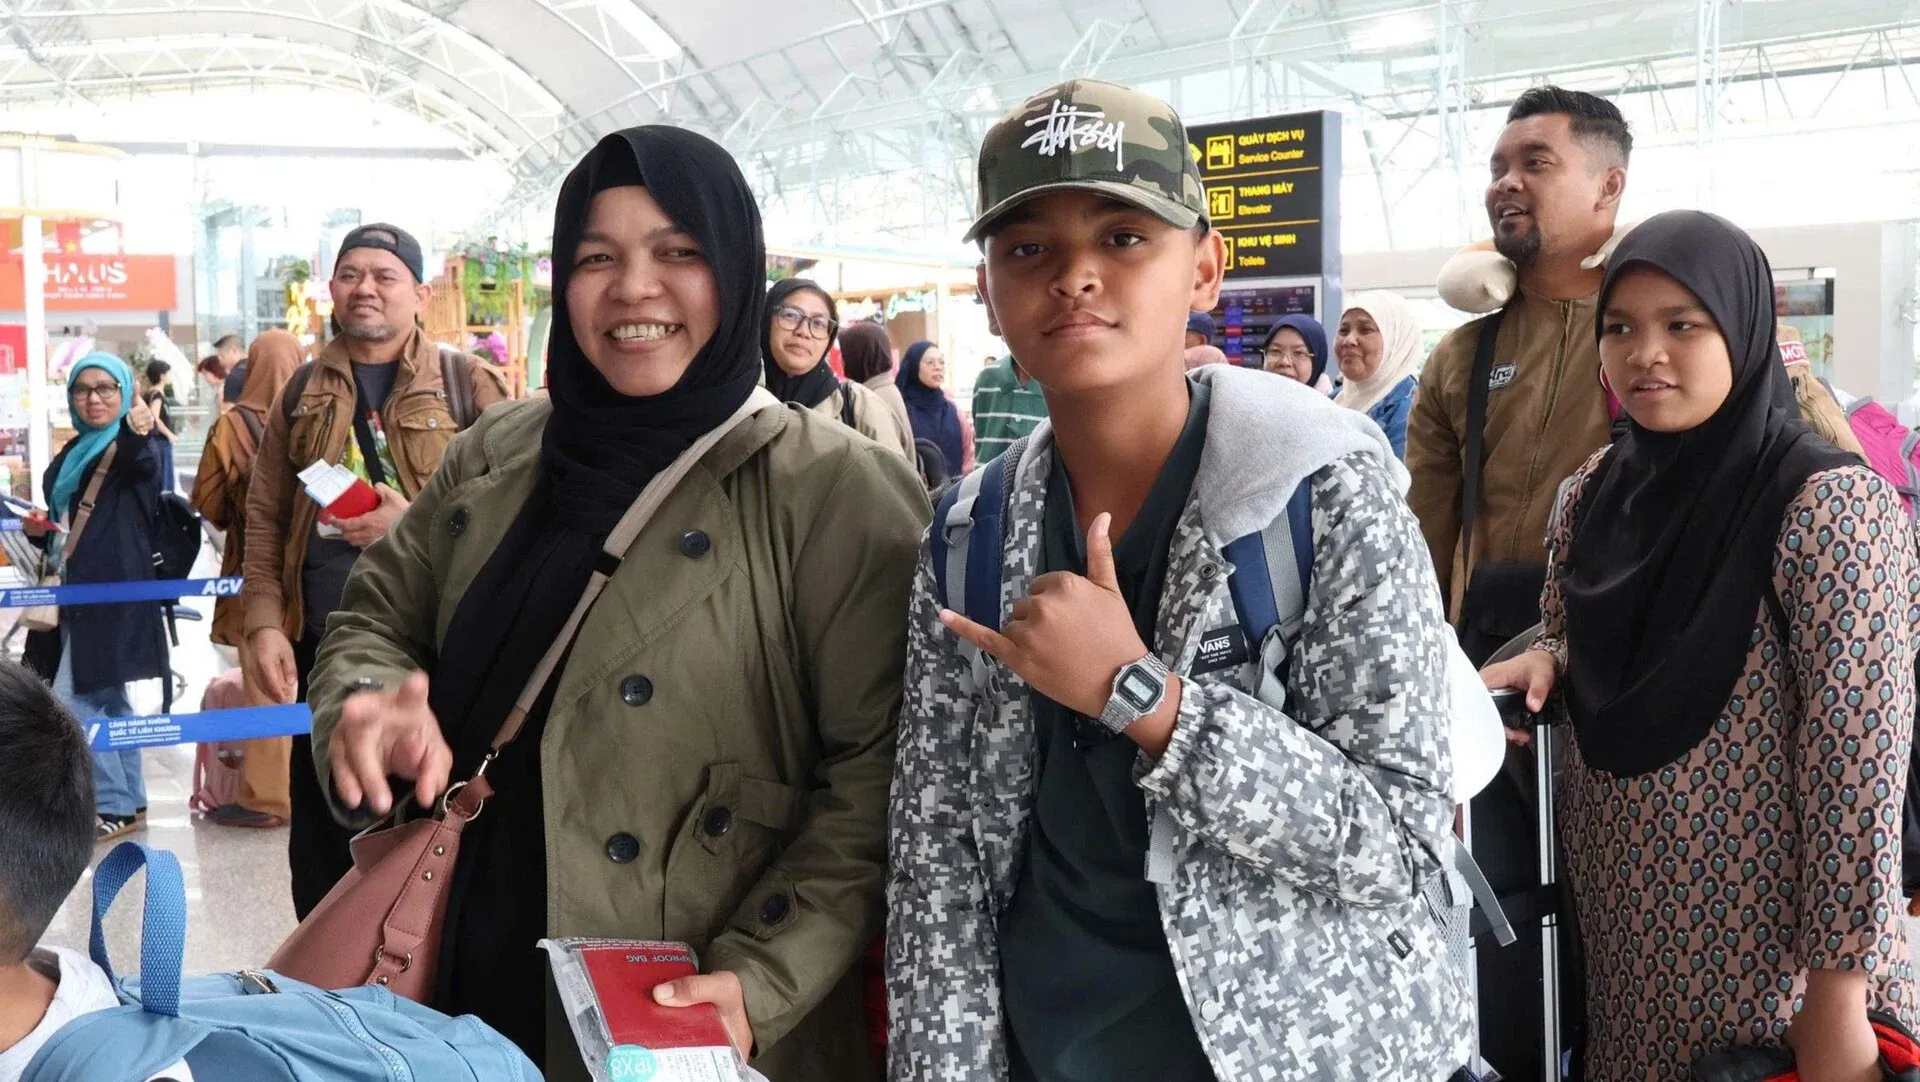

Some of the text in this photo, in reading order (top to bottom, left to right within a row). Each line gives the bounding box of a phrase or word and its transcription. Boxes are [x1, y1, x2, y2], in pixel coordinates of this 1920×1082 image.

[1266, 131, 1290, 145] DỊCH
[1290, 129, 1305, 142] VỤ
[1238, 150, 1305, 165] Service Counter
[1238, 181, 1294, 197] THANG MÁY
[1238, 204, 1272, 215] Elevator
[1238, 234, 1296, 248] KHU VỆ SINH
[1238, 256, 1266, 267] Toilets
[201, 578, 243, 595] ACV
[1198, 635, 1231, 654] VANS
[626, 954, 648, 963] BAG
